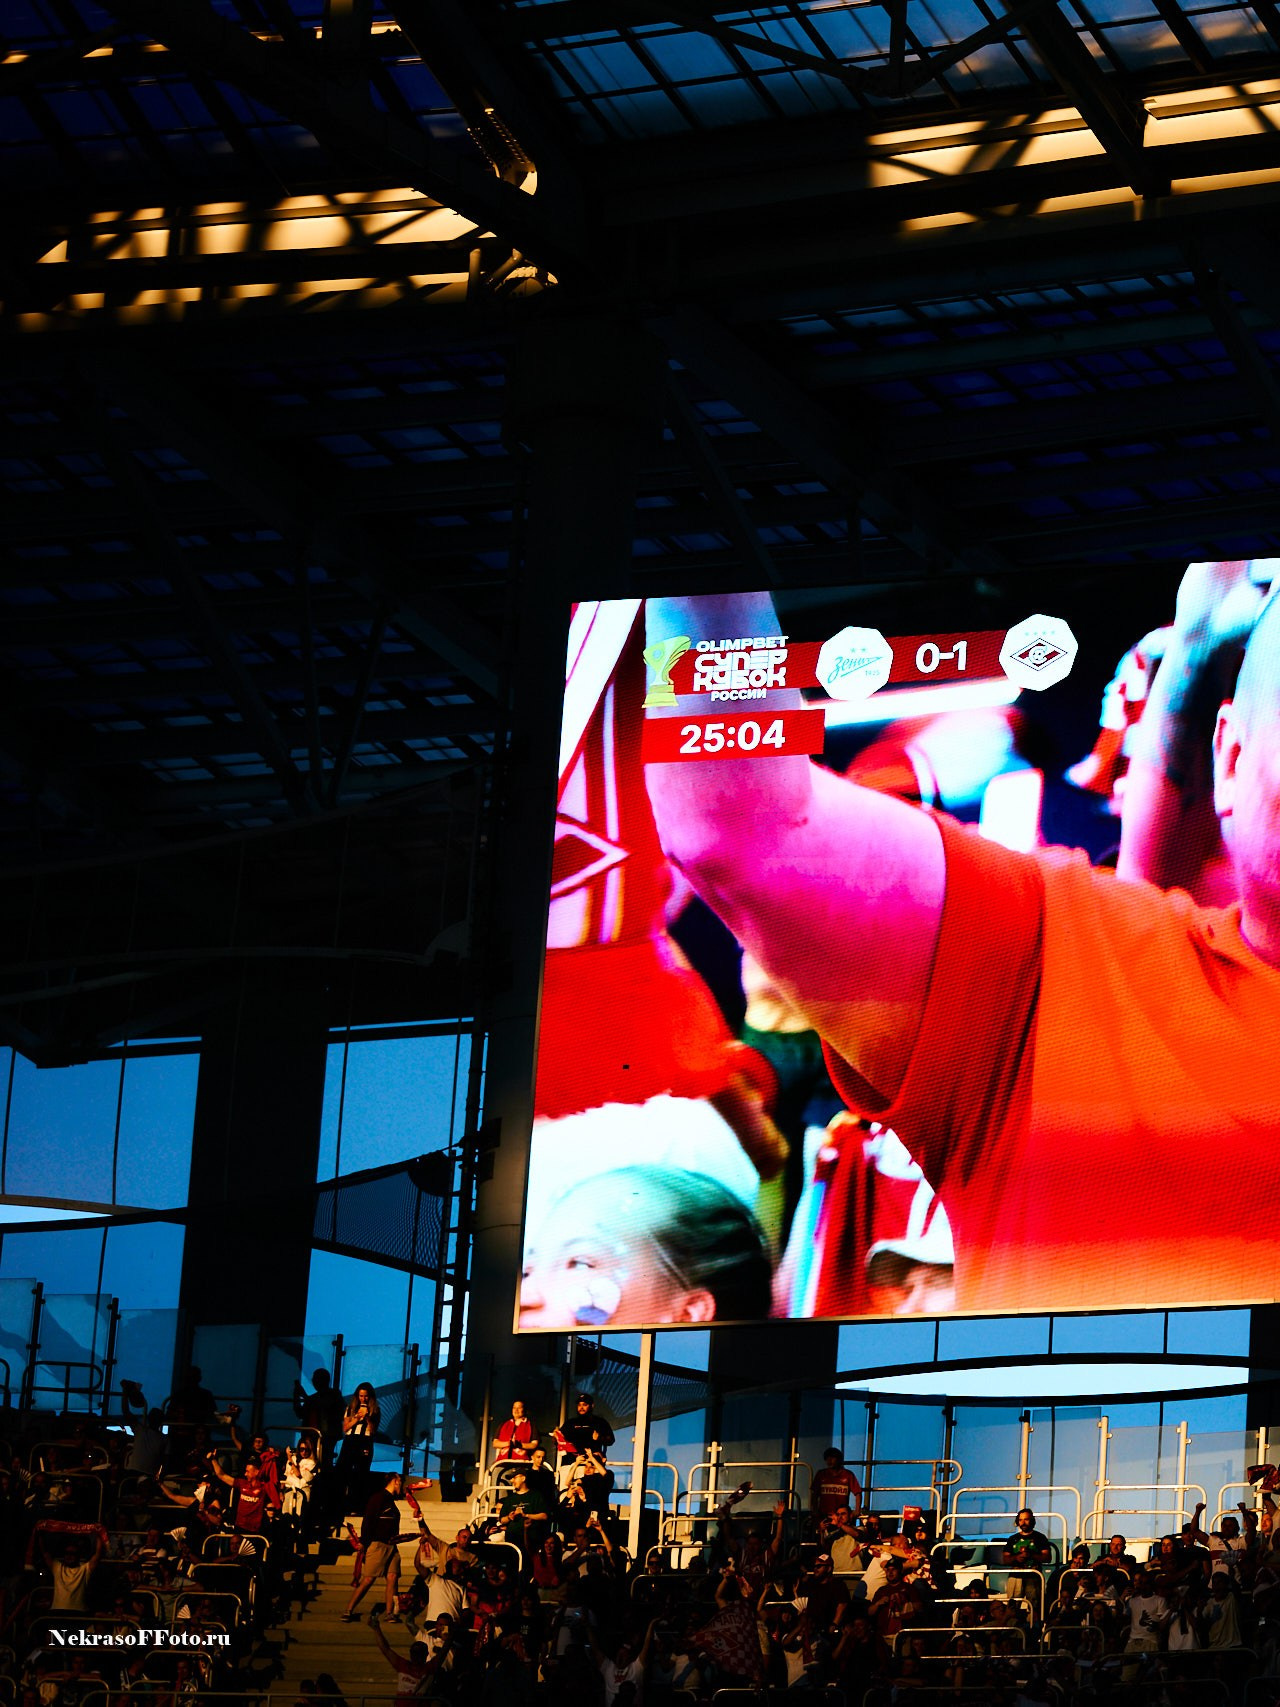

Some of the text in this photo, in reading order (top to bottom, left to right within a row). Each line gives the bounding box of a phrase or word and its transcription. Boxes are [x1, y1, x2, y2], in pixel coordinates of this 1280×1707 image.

[696, 635, 789, 653] OLIMPBET
[694, 648, 788, 673] СУПЕР
[915, 640, 967, 674] 0-1
[693, 667, 787, 691] КУБОК
[711, 688, 767, 701] РОССИИ
[679, 719, 786, 754] 25:04
